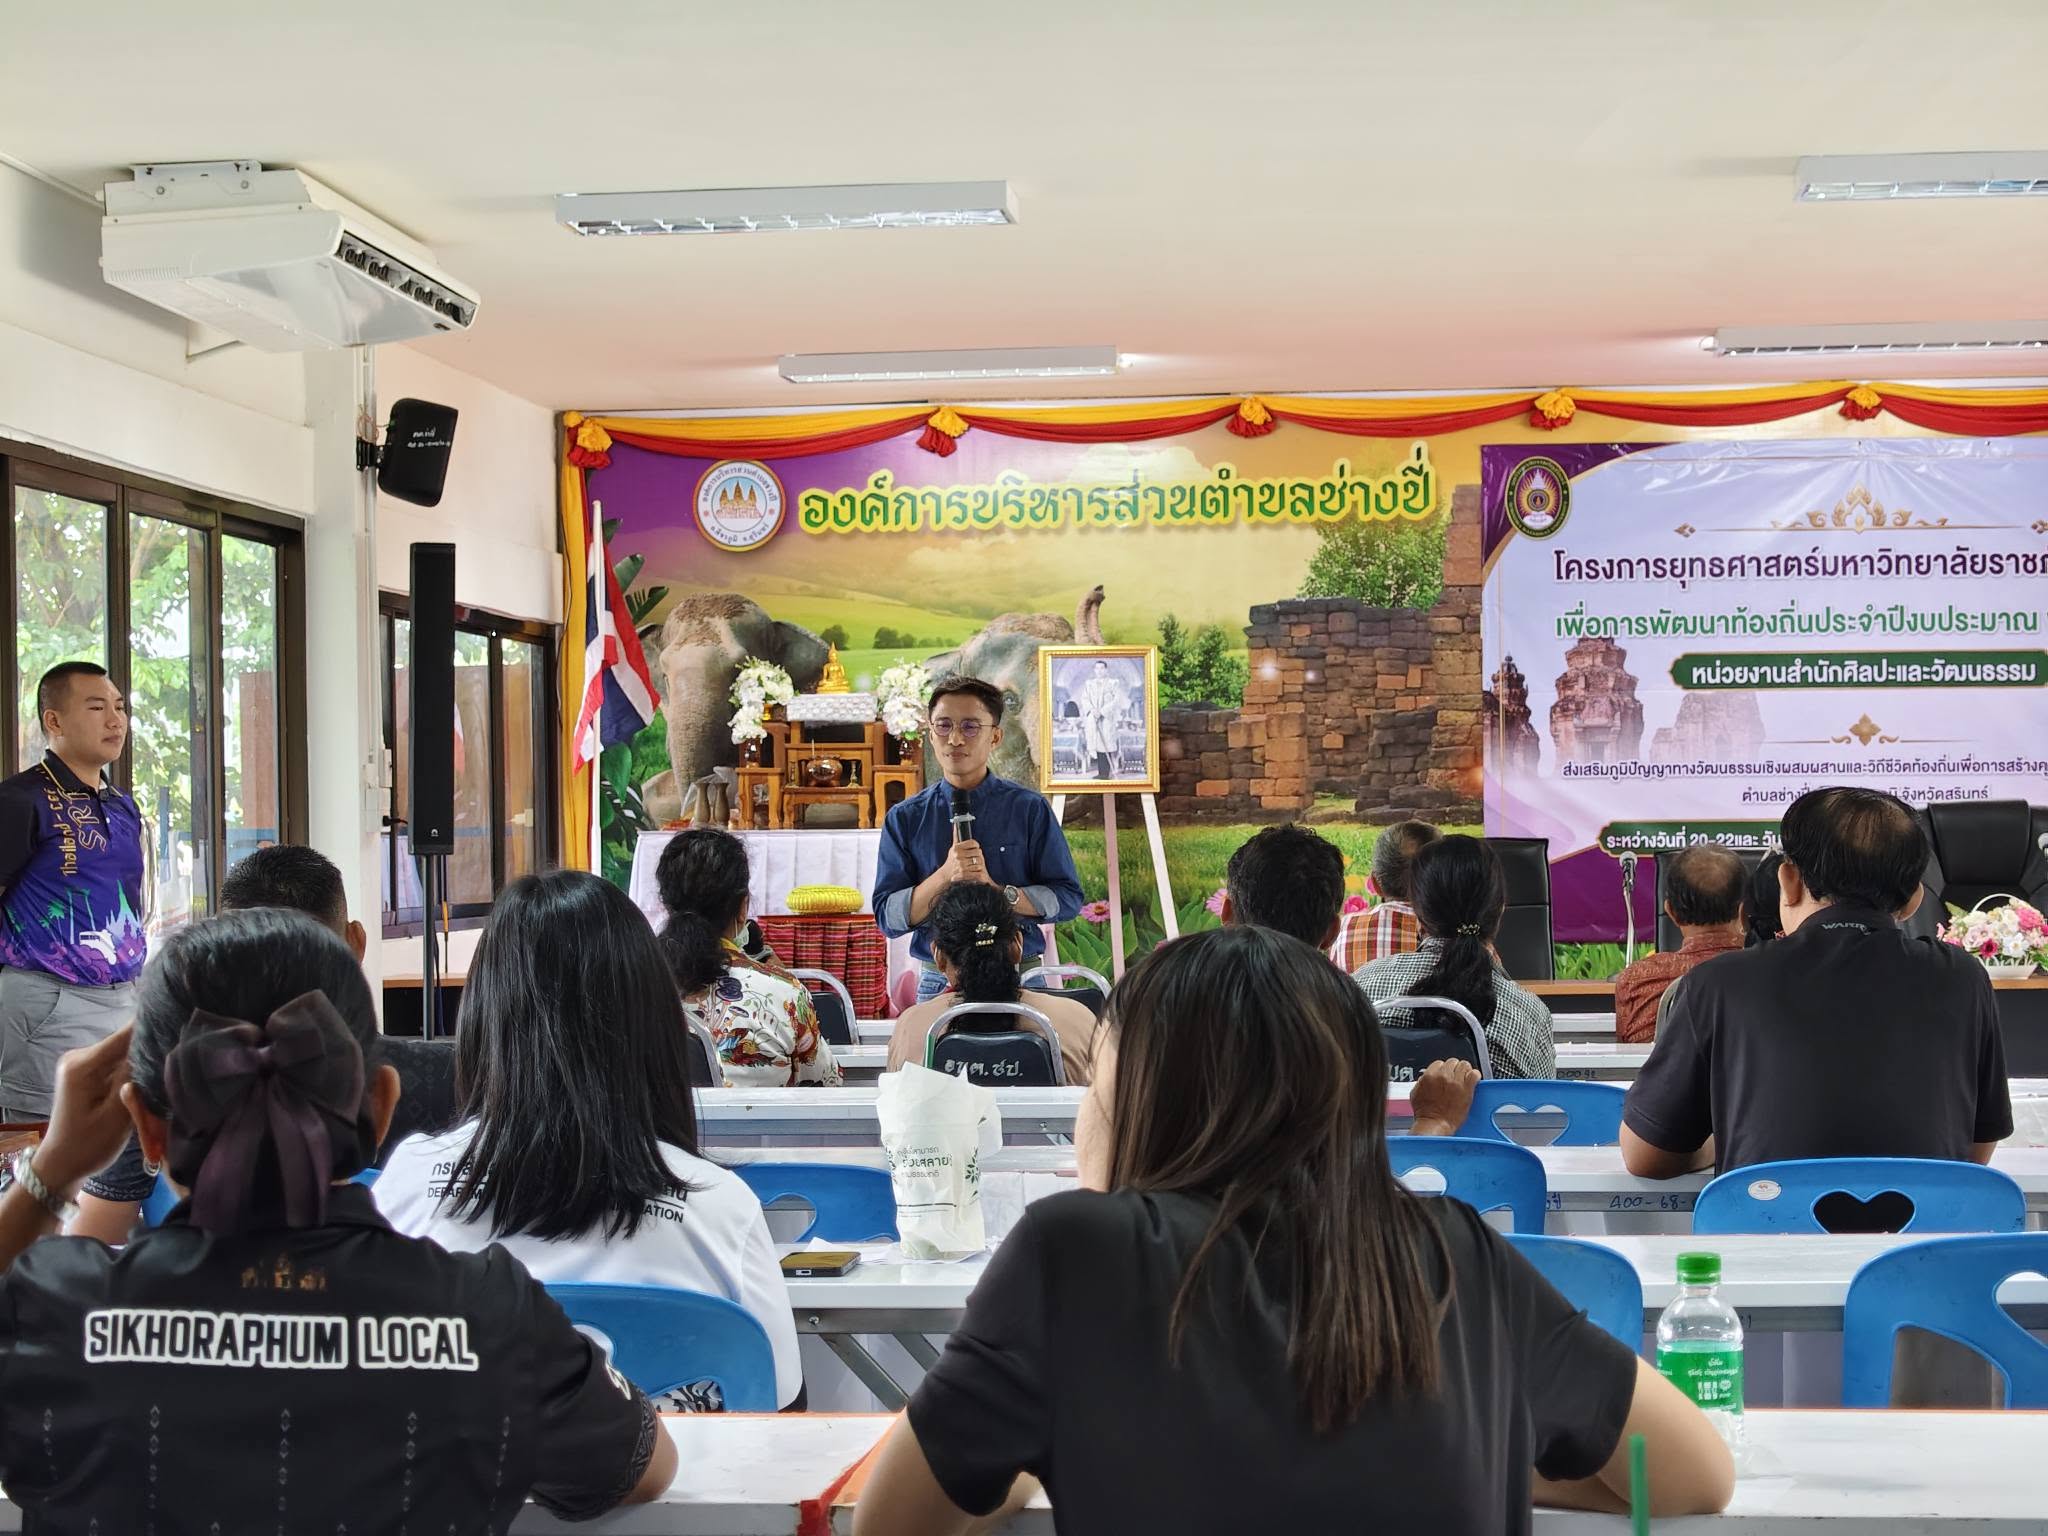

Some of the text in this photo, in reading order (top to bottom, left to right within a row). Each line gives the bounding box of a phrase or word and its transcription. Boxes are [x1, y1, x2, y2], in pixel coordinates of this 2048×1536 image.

[802, 447, 1431, 528] องค์การบริหารส่วนตำบลช่างปี่
[1556, 600, 2038, 637] เพื่อการพัฒนาท้องถิ่นประจำปีงบประมาณ
[1691, 655, 2036, 686] หน่วยงานสำนักศิลปะและวัฒนธรรม
[1606, 826, 1686, 849] ระหว่างวันที่
[84, 1311, 479, 1371] SIKHORAPHUM LOCAL
